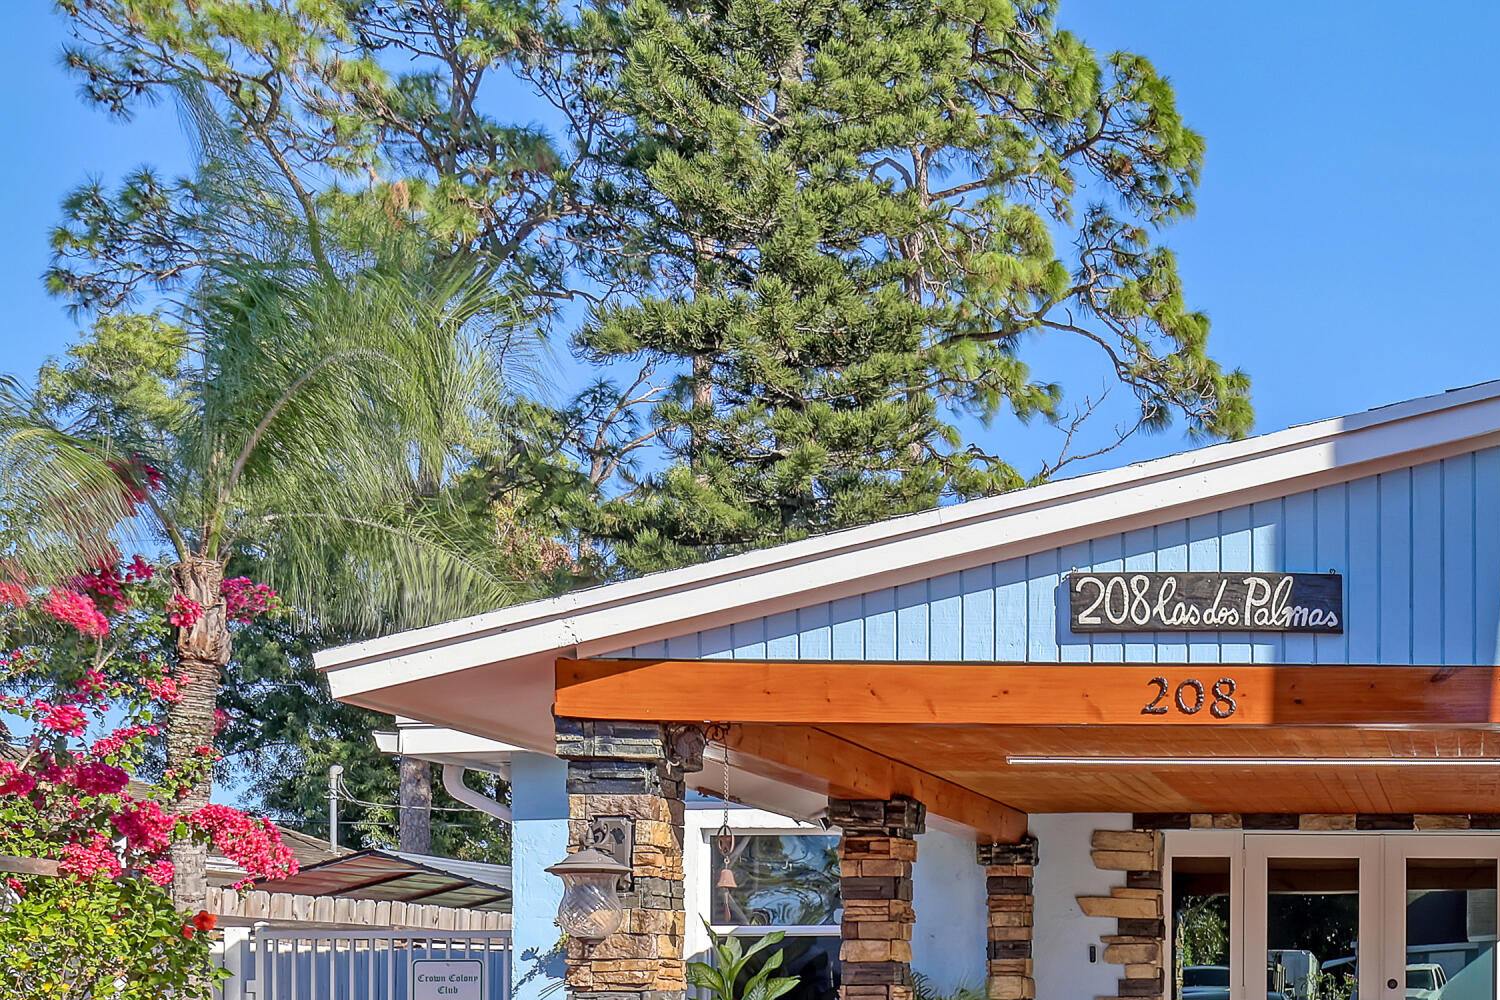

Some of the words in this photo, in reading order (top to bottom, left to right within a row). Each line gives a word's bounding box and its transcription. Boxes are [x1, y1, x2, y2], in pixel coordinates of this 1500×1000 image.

[1075, 574, 1151, 625] 208
[1202, 579, 1240, 625] dos
[1242, 575, 1339, 628] Palmas
[1142, 676, 1237, 718] 208
[417, 974, 446, 982] Crown
[448, 974, 479, 982] Colony
[437, 986, 459, 994] Club
